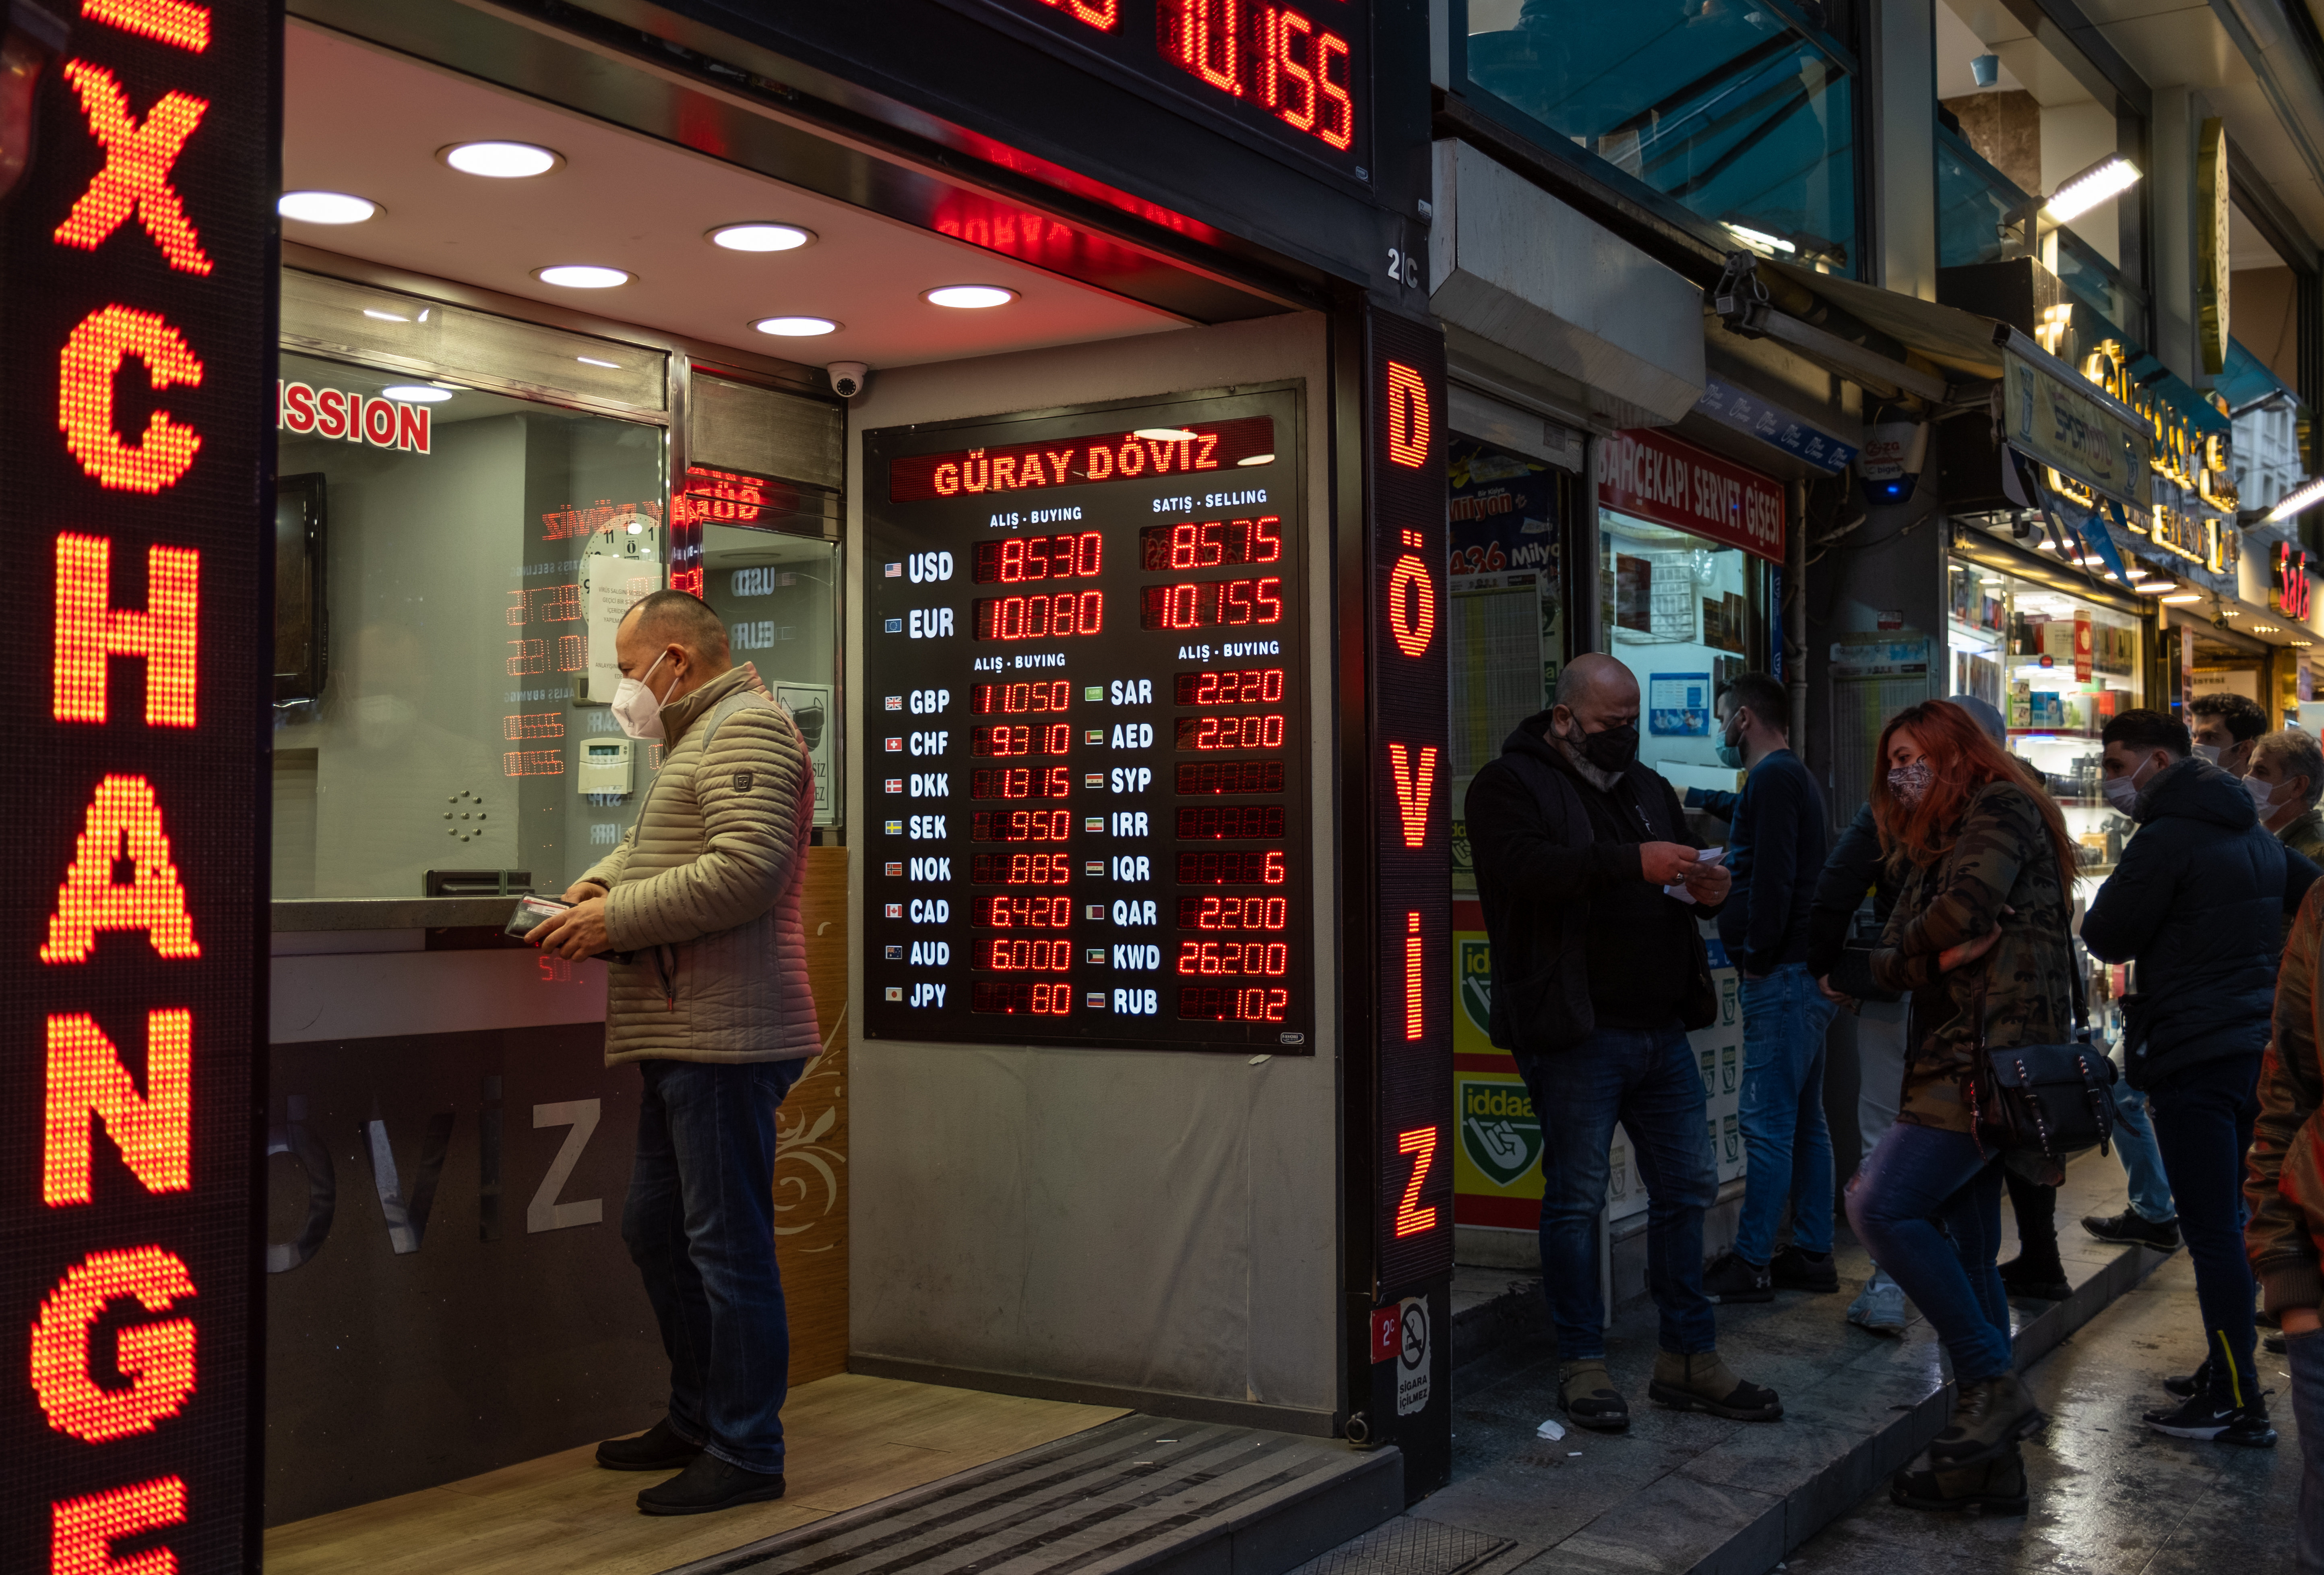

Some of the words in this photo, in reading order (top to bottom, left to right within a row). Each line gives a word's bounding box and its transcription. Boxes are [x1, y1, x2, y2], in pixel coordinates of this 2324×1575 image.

[934, 449, 1074, 495] GÜRAY
[1089, 429, 1218, 480] DÖVİZ
[1153, 496, 1192, 513] SATIŞ
[1205, 489, 1266, 508] SELLING
[1598, 437, 1690, 512] BAHÇEKAPI
[1694, 465, 1741, 529] SERVET
[1745, 481, 1780, 547] GİŞESİ
[990, 513, 1019, 529] ALIŞ
[1031, 506, 1082, 523] BUYING
[603, 530, 614, 544] 11
[648, 527, 654, 542] 1
[909, 552, 953, 583] USD
[1511, 542, 1560, 568] Milyo
[909, 608, 954, 639] EUR
[974, 656, 1003, 673] ALIŞ
[1015, 653, 1065, 668] BUYING
[1178, 645, 1210, 662] ALIŞ
[1223, 641, 1279, 657] BUYING
[910, 689, 950, 714] GBP
[1111, 679, 1152, 705] SAR
[910, 731, 948, 756] CHF
[1111, 723, 1153, 749] AED
[31, 0, 213, 1575] XCHANG
[911, 773, 949, 797] DKK
[1111, 767, 1151, 793] SYP
[1388, 361, 1438, 1237] DÖVİZ
[909, 815, 946, 840] SEK
[1112, 812, 1148, 837] IRR
[911, 857, 951, 881] NOK
[1113, 856, 1149, 882] IQR
[910, 899, 949, 924] CAD
[1113, 899, 1156, 927] QAR
[911, 941, 950, 965] AUD
[1113, 944, 1160, 969] KWD
[911, 983, 946, 1008] JPY
[1114, 988, 1157, 1014] RUB
[1399, 1375, 1427, 1394] SİGARA
[1399, 1387, 1428, 1410] İÇİLMEZ
